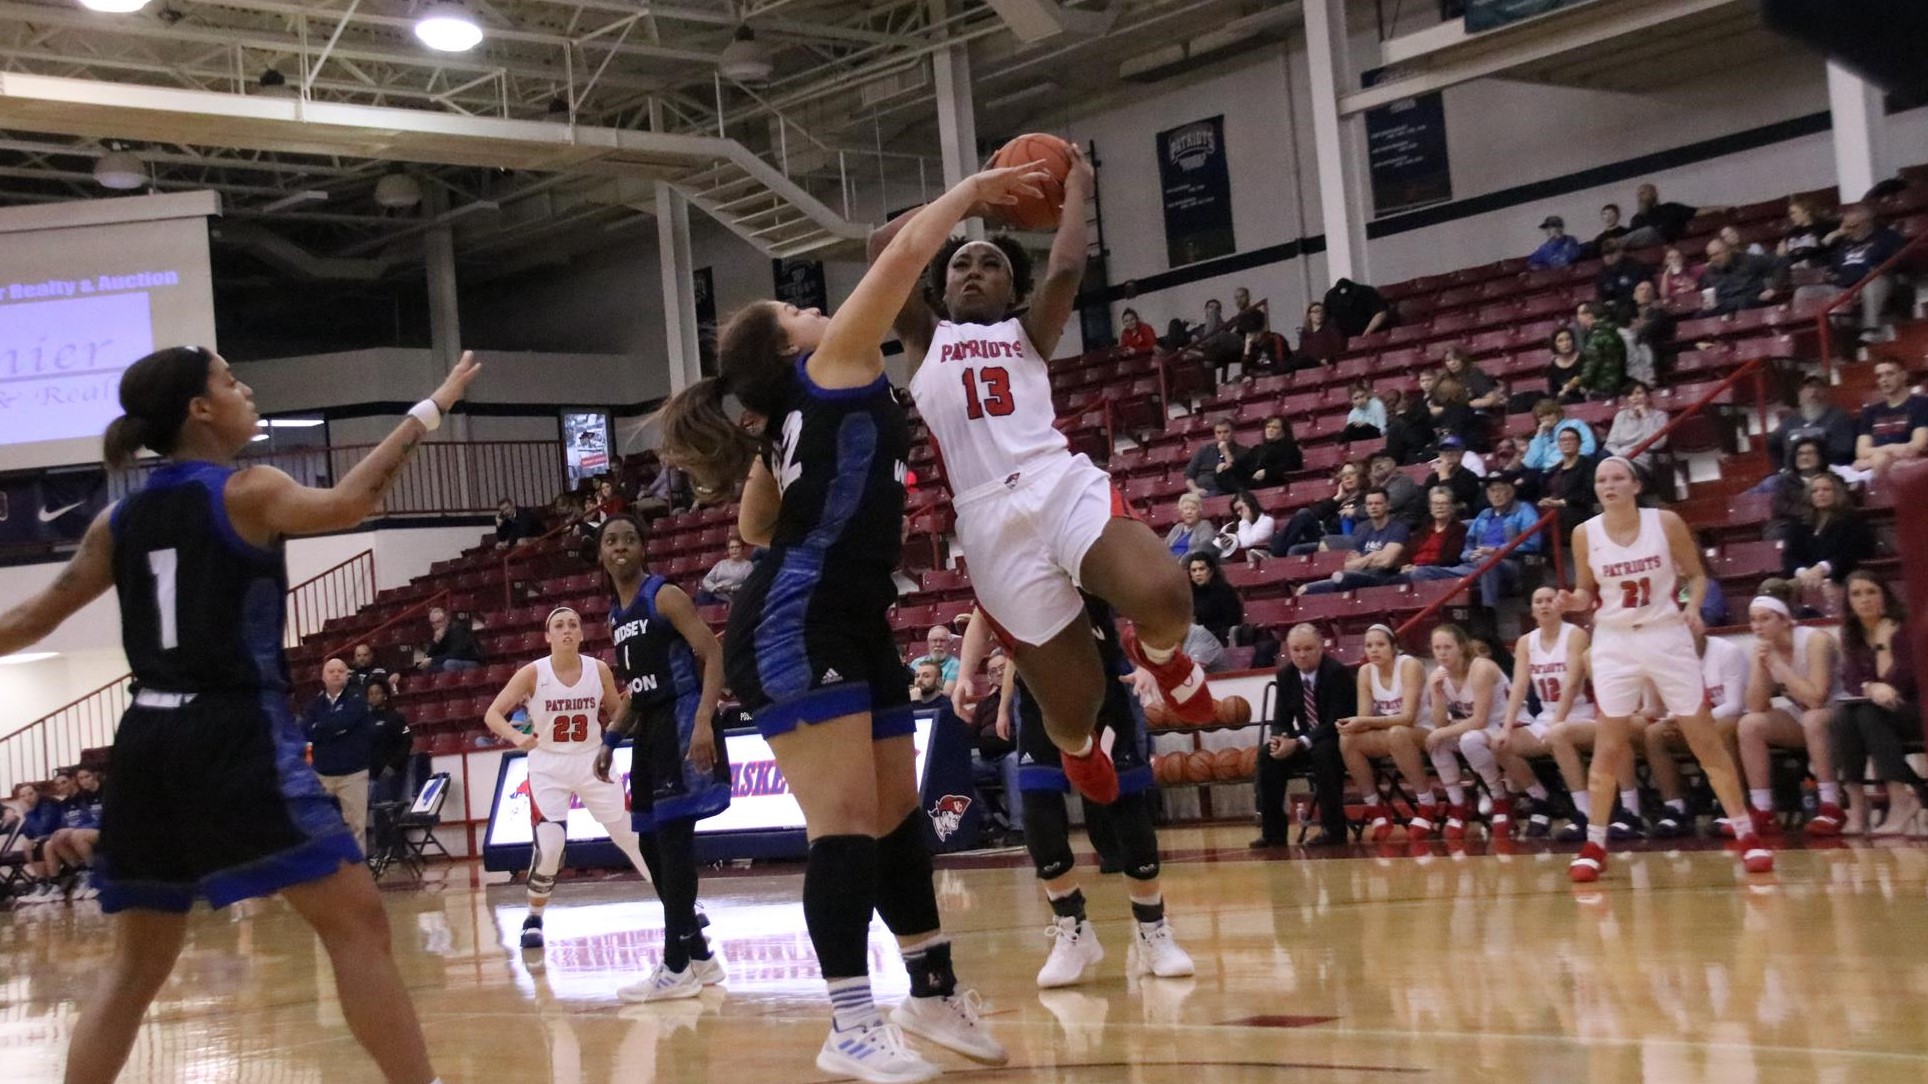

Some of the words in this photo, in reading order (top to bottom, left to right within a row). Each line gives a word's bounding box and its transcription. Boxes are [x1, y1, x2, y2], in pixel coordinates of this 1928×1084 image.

[9, 279, 76, 300] Realty
[80, 279, 95, 293] &
[98, 270, 179, 292] Auction
[940, 340, 1024, 363] PATRIOTS
[962, 366, 1015, 420] 13
[1602, 555, 1661, 577] PATRIOTS
[148, 548, 178, 650] 1
[1620, 576, 1651, 608] 21
[1538, 677, 1561, 702] 12
[545, 697, 596, 712] PATRIOTS
[553, 714, 589, 743] 23
